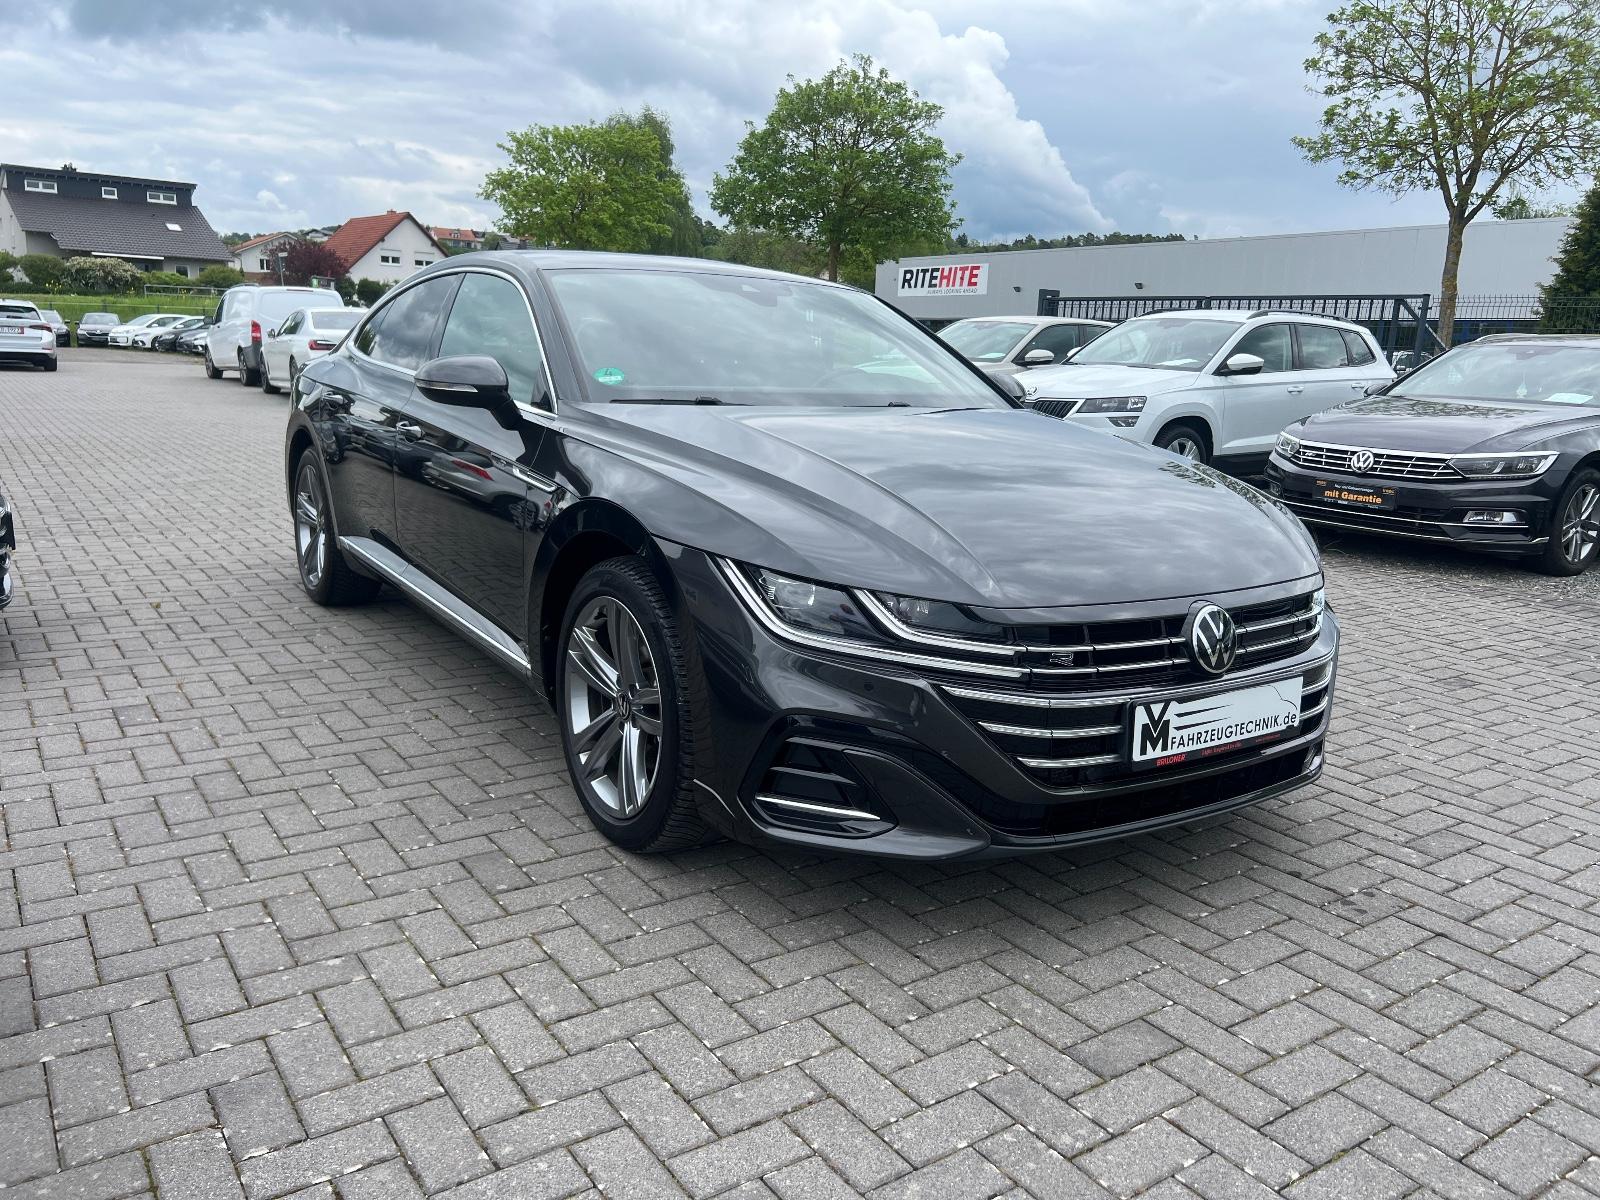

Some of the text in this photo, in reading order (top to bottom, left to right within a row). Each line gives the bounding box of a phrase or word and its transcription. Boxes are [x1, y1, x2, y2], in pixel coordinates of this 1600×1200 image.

[901, 266, 981, 289] RITEHITE
[1324, 489, 1340, 498] mit
[1341, 491, 1382, 504] Garantie
[1170, 711, 1297, 750] FAHRZEUGTECHNIK.de
